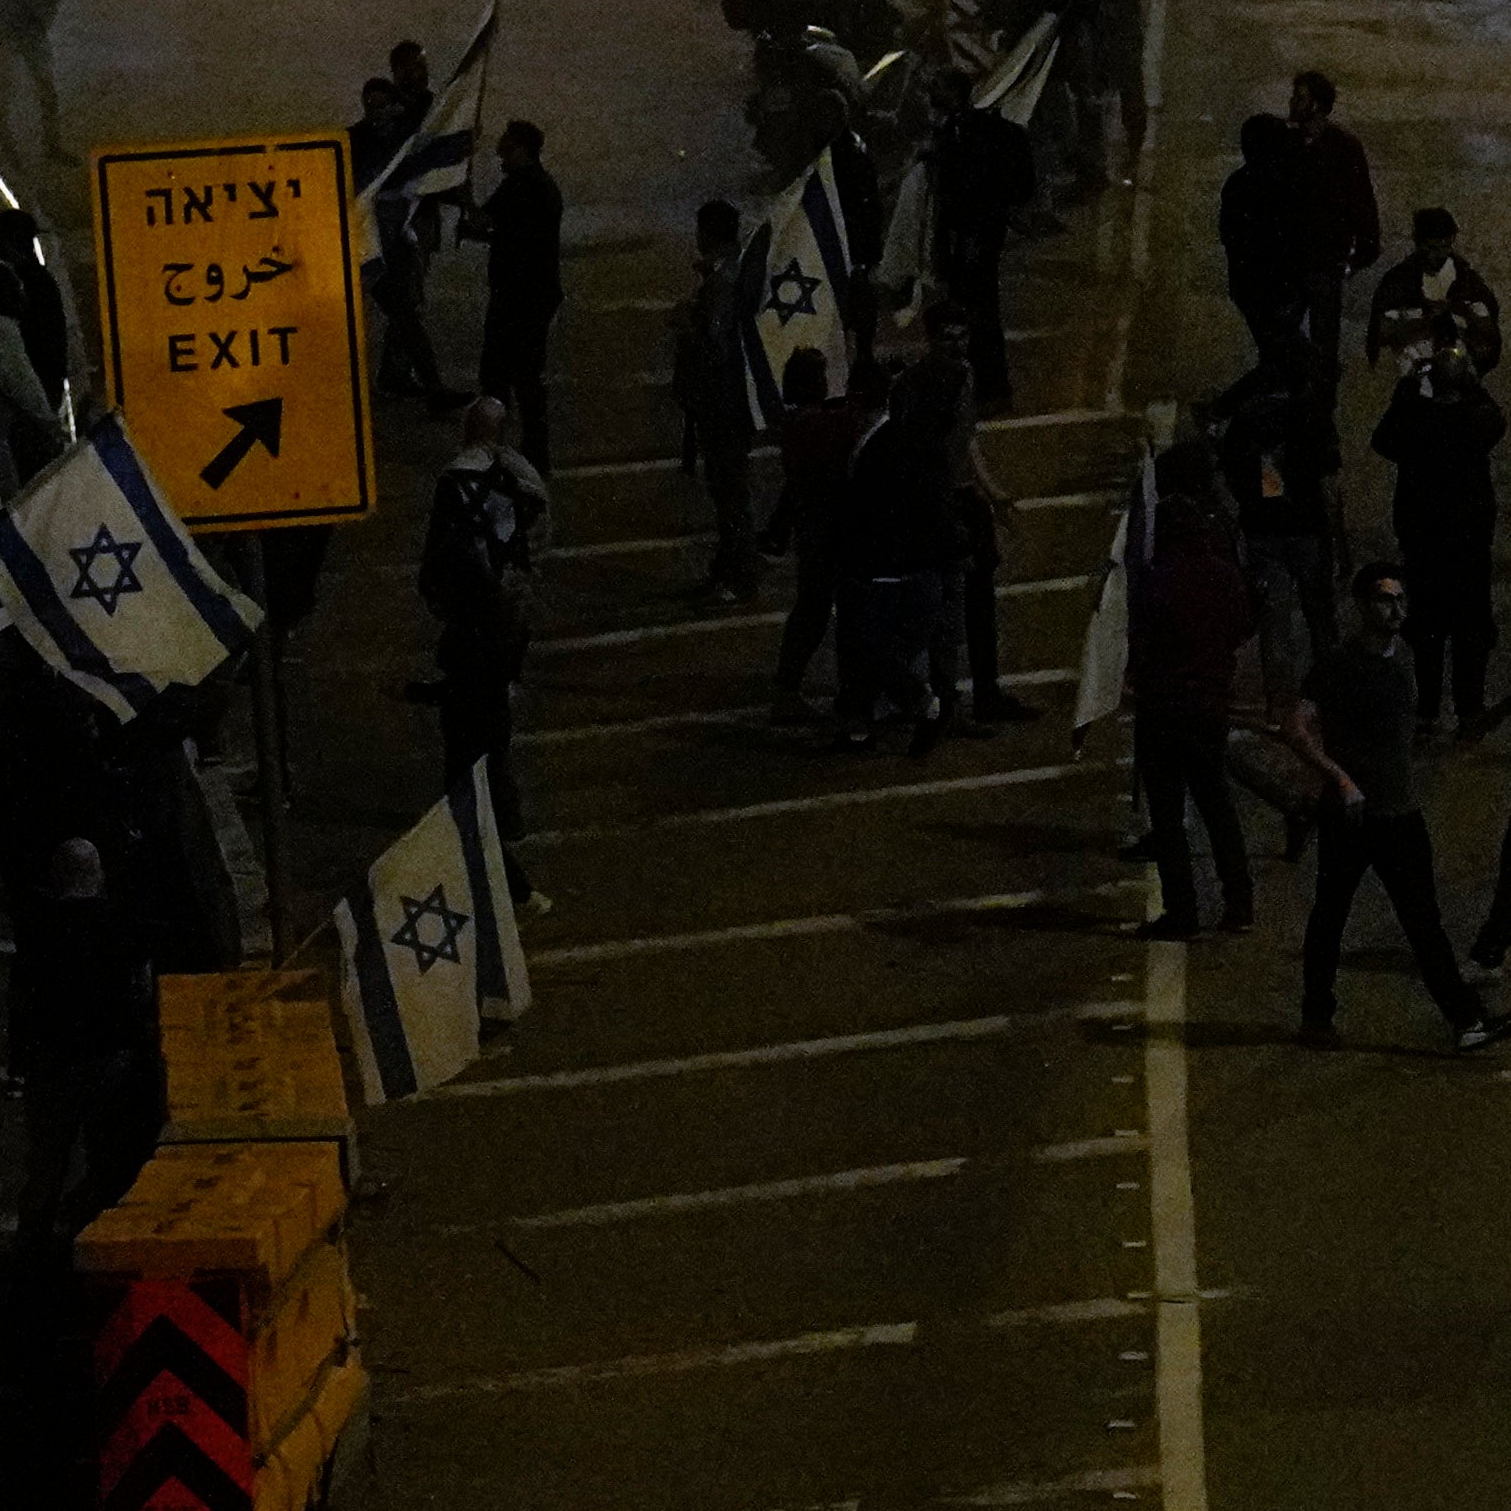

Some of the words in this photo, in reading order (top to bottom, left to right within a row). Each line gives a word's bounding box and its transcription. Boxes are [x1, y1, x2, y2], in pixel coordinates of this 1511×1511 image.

[146, 179, 301, 226] יציאה
[162, 246, 295, 306] خروج
[168, 327, 298, 372] EXIT
